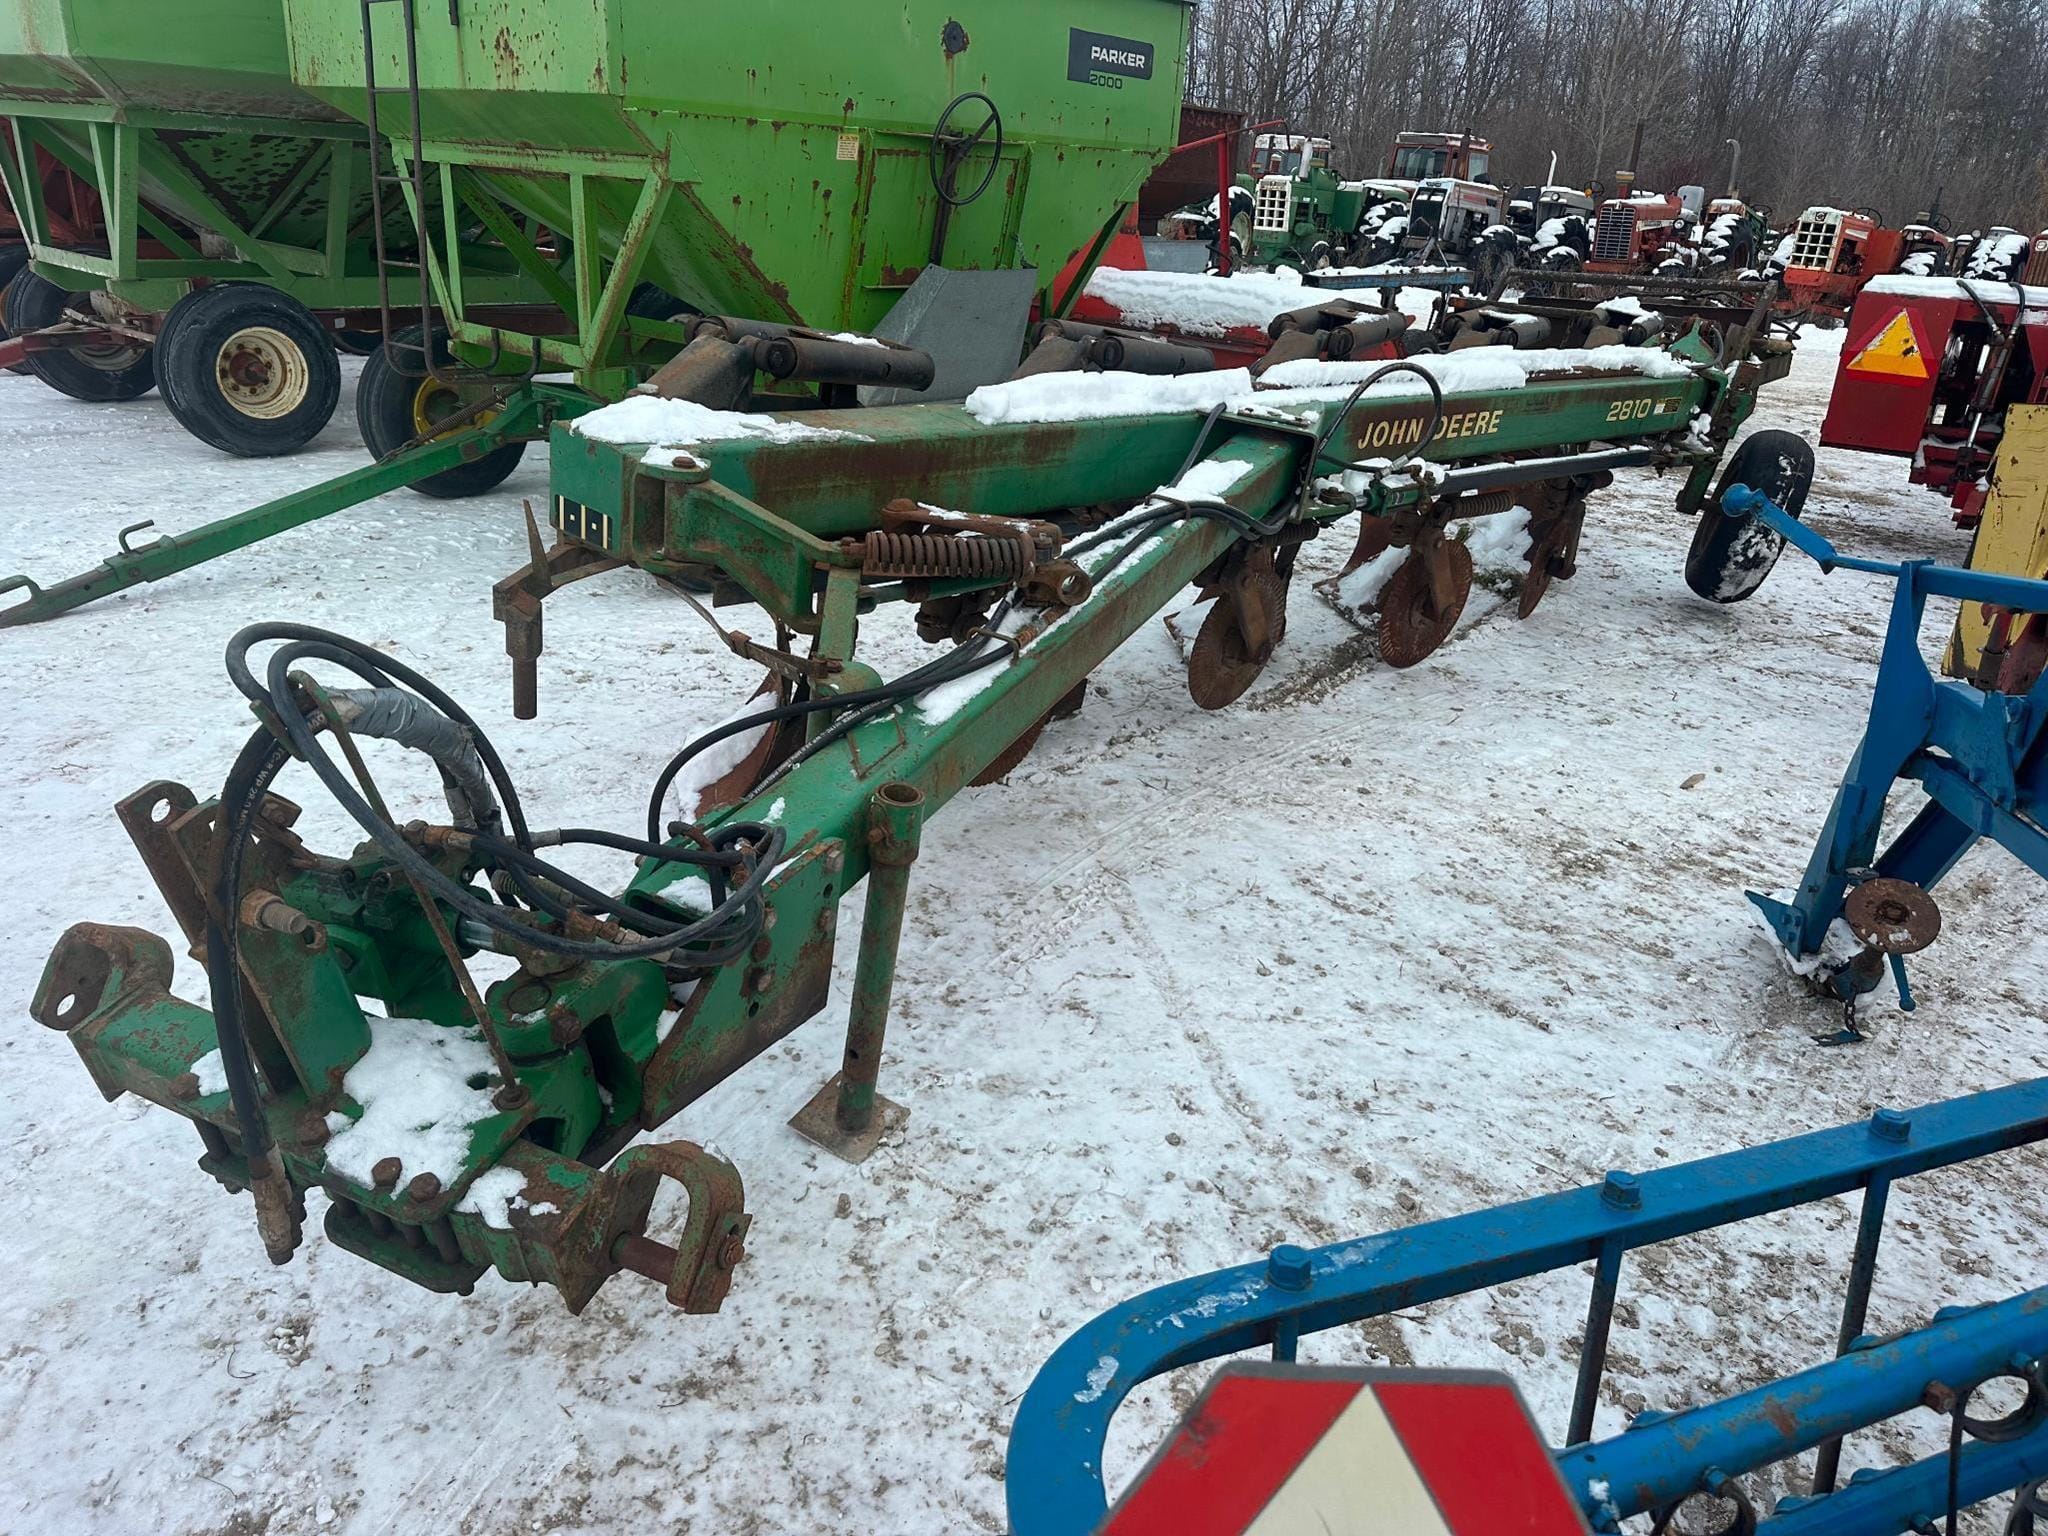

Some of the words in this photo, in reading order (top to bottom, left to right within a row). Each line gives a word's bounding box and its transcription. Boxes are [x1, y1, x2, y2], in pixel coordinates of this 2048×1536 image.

[1091, 45, 1145, 69] PARKER
[1090, 73, 1122, 90] 2000
[1605, 398, 1652, 422] 2810
[1357, 417, 1425, 450] JOHN
